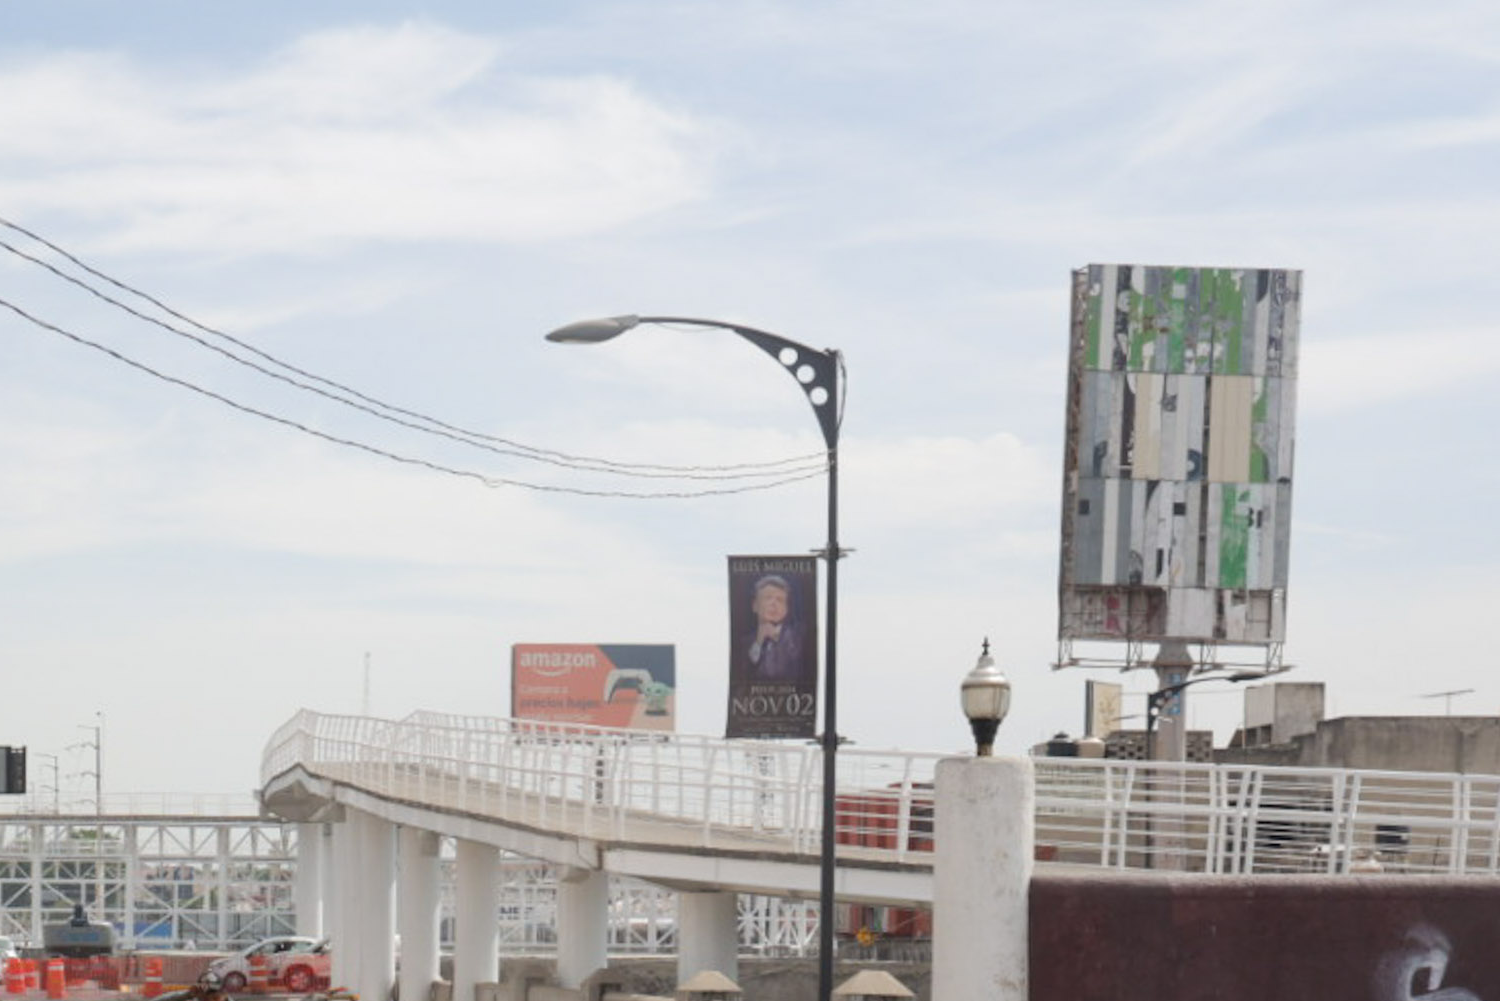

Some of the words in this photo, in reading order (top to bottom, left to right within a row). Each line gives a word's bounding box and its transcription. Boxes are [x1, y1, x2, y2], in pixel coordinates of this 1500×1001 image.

[520, 652, 596, 667] amazon
[732, 695, 784, 716] NOV
[785, 692, 814, 716] 02
